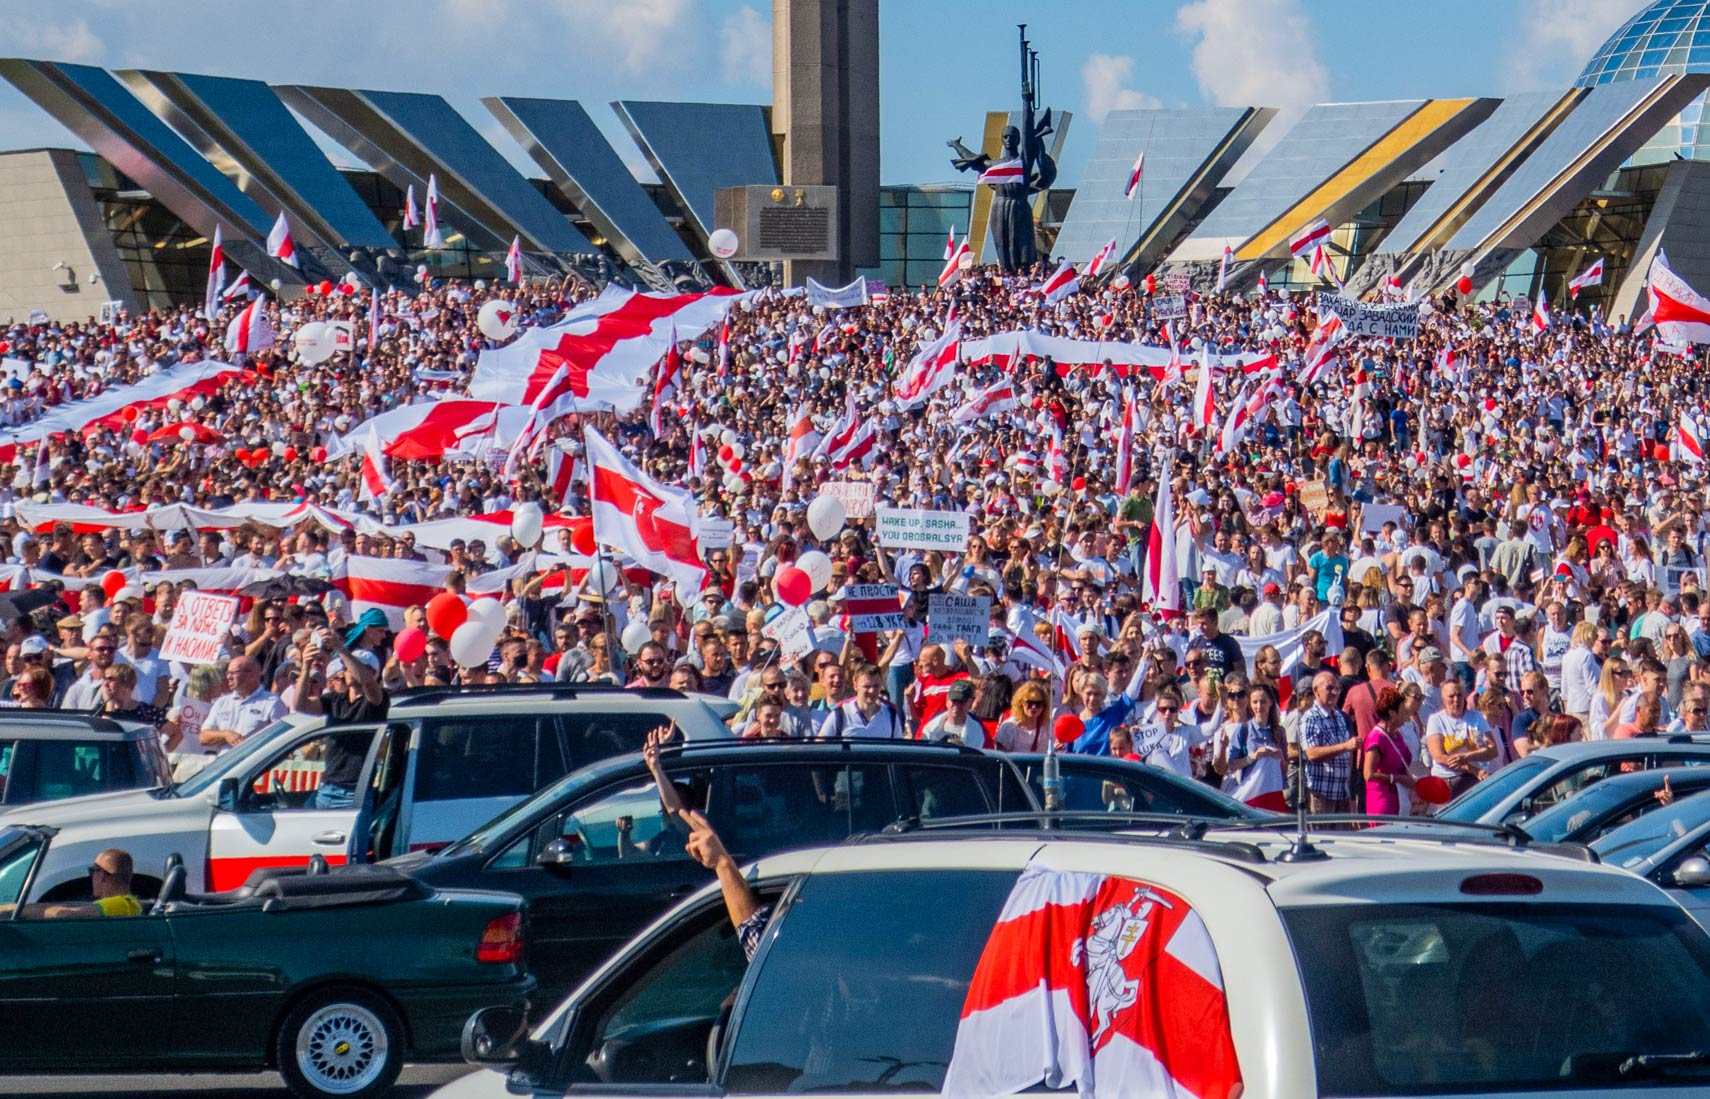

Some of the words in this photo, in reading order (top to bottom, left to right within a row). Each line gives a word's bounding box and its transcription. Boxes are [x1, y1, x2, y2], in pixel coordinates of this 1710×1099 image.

[1359, 310, 1417, 325] ЗАВАДСКИЙ
[1370, 323, 1377, 334] С
[1385, 324, 1416, 337] НАМИ
[882, 518, 905, 527] WAKE
[882, 531, 900, 540] YOU
[903, 532, 962, 543] OBOSRALSYA
[847, 586, 858, 598] НЕ
[192, 597, 235, 623] ОТВЕТУ
[174, 614, 188, 629] ЗА
[189, 617, 217, 636] ЛОЖЬ
[163, 635, 173, 653] И
[173, 636, 224, 662] НАСИЛИЕ
[1134, 728, 1158, 741] STOP
[1138, 742, 1163, 754] LUKA
